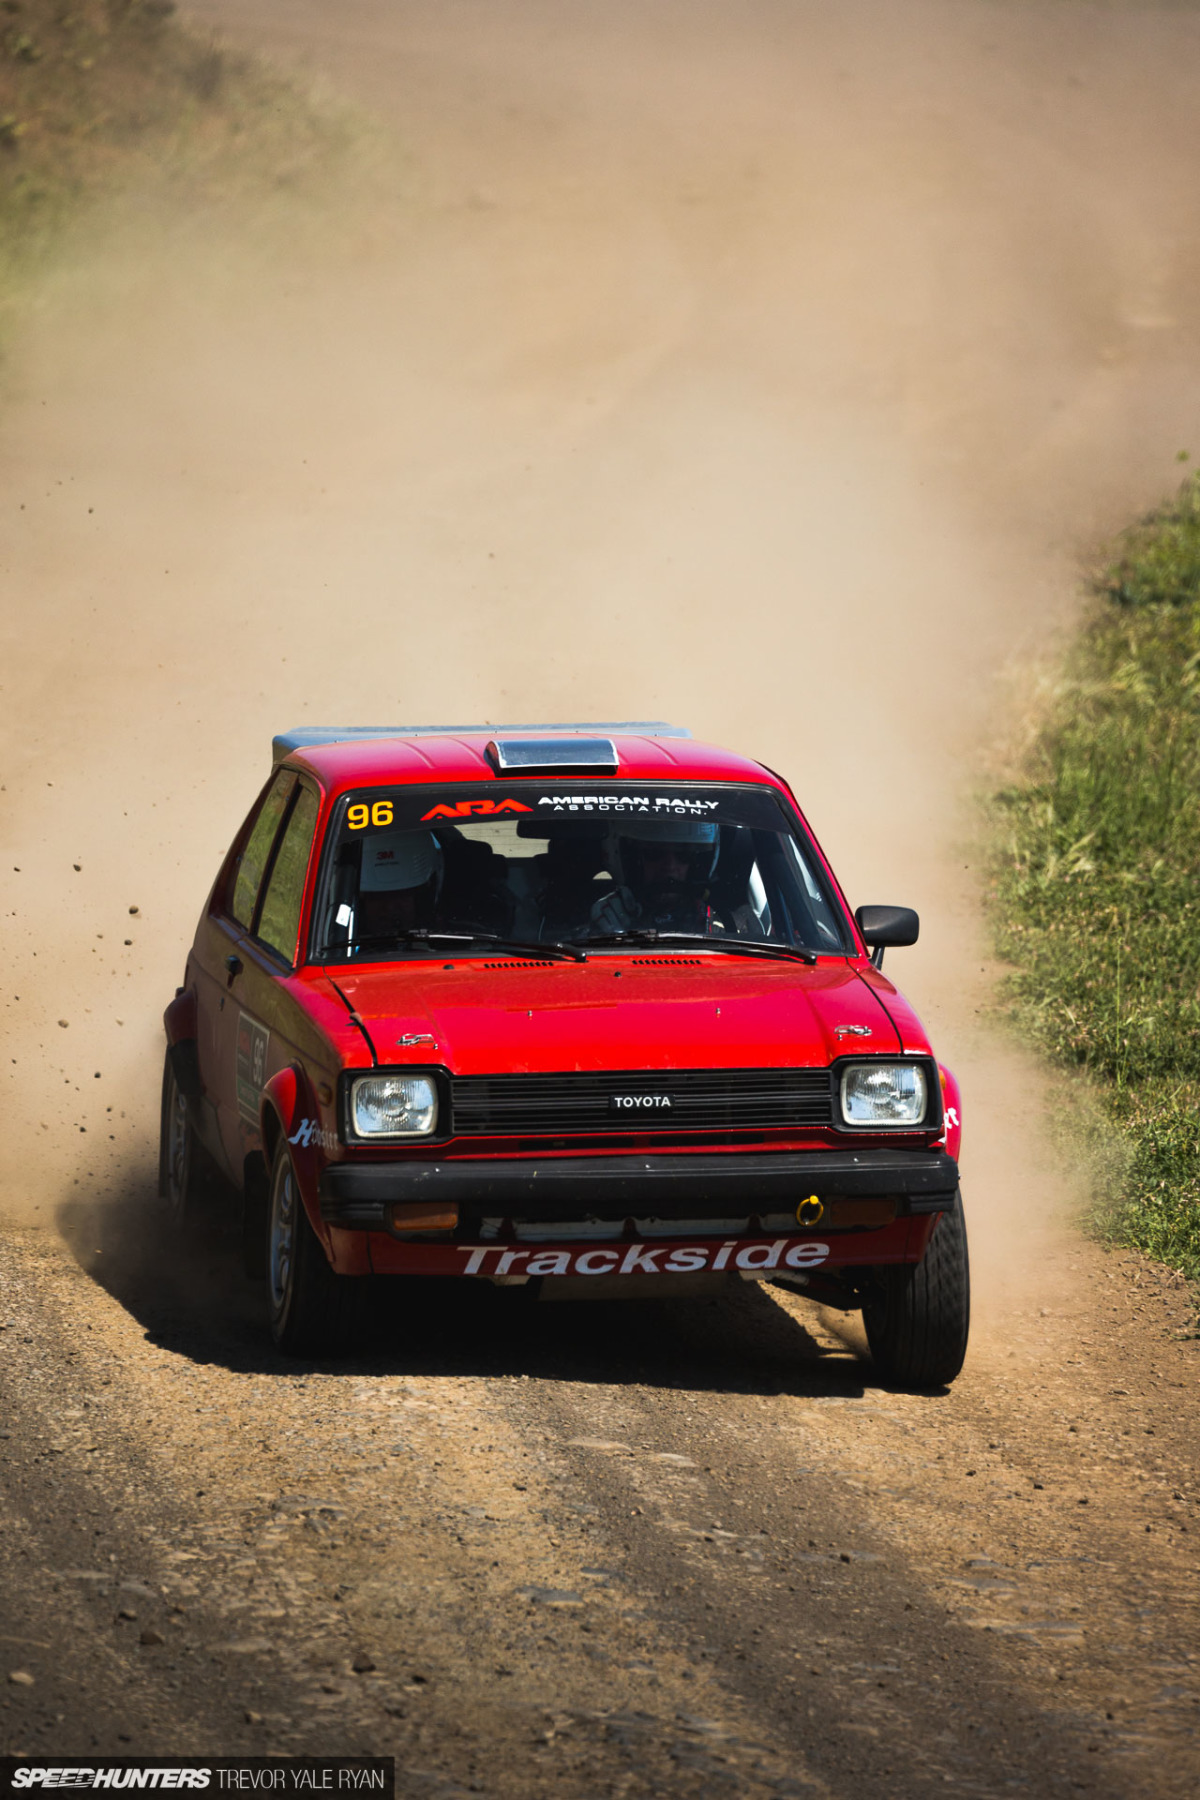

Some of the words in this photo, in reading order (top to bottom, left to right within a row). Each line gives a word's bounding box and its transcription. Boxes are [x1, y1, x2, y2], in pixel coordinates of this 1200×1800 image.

[420, 798, 534, 822] ARA
[538, 796, 650, 806] AMERICAN
[656, 798, 719, 810] RALLY
[347, 801, 394, 830] 96
[376, 851, 394, 860] 3M
[614, 1096, 671, 1108] TOYOTA
[456, 1238, 830, 1276] Trackside
